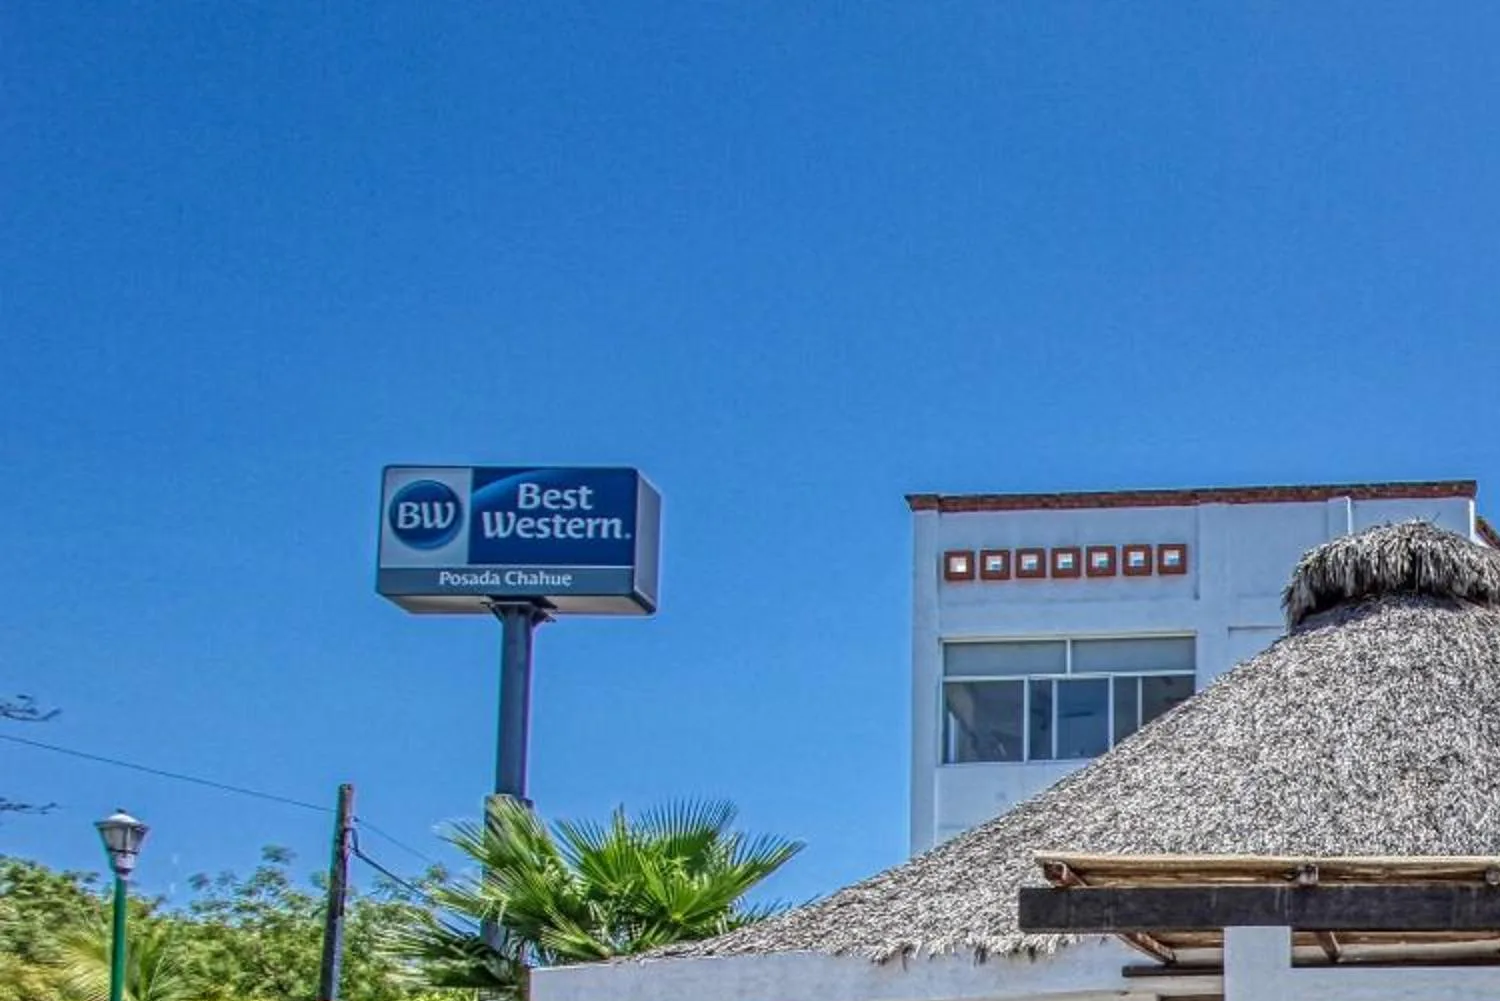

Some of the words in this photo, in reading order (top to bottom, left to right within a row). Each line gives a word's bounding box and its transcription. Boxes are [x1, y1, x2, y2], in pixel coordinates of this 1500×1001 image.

[517, 483, 593, 509] Best
[397, 501, 454, 529] BW
[439, 571, 500, 586] Posada
[505, 571, 573, 586] Chahue
